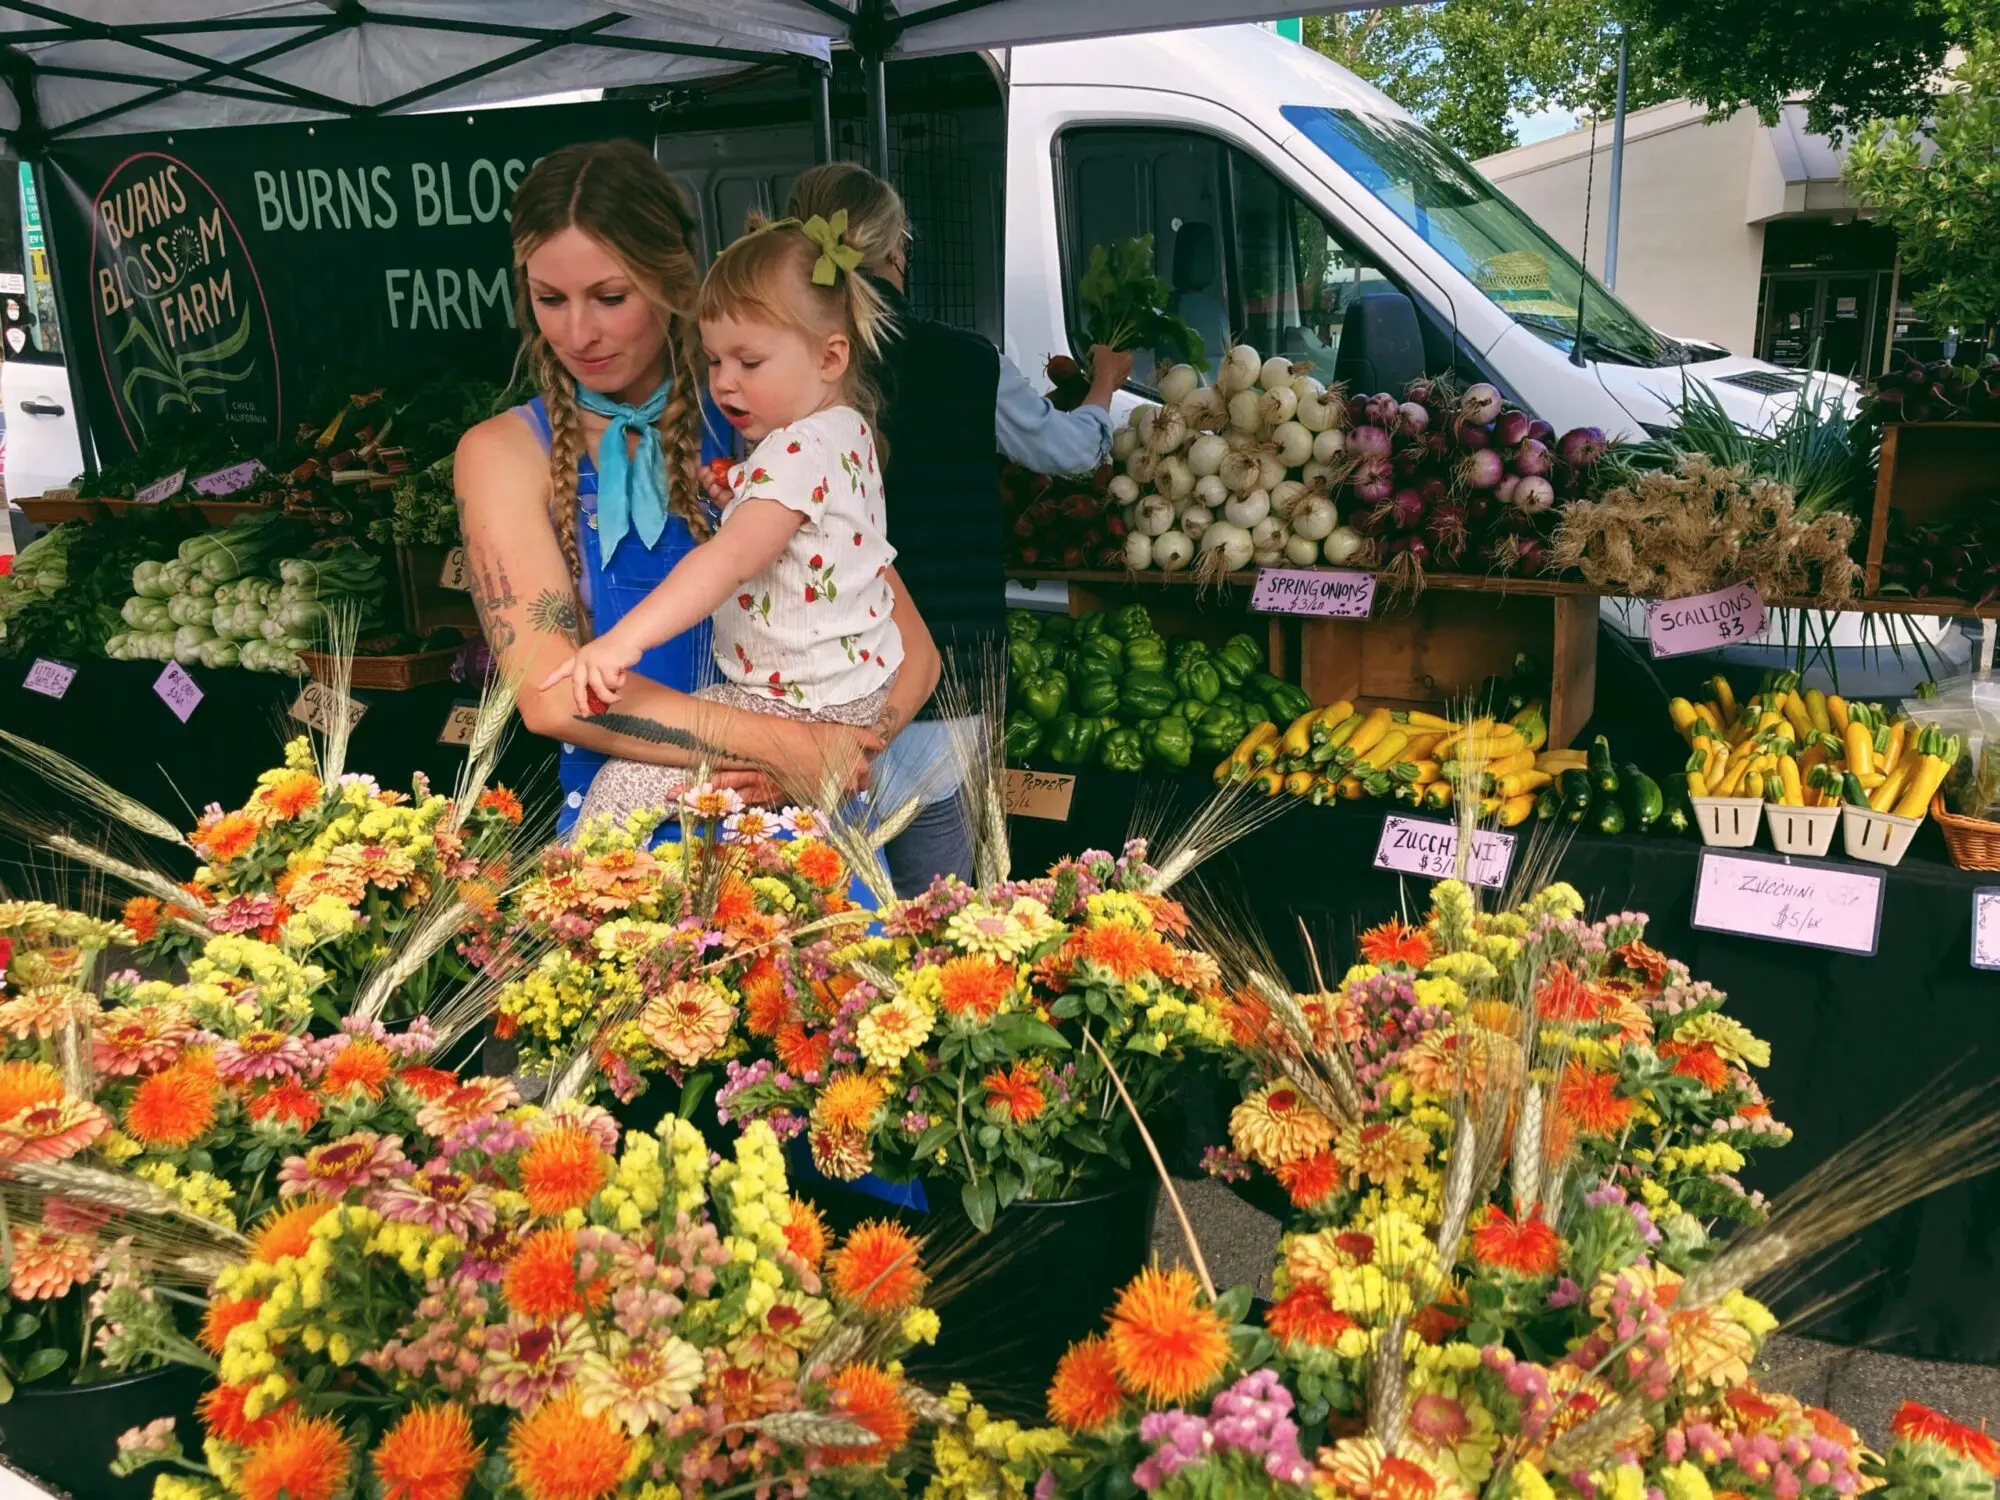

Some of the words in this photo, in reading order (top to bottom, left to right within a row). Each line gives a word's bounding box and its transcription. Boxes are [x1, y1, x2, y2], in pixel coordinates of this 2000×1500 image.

[100, 165, 187, 249] BURNS
[254, 165, 398, 231] BURNS
[411, 157, 545, 227] BLOS
[160, 269, 235, 348] FARM
[385, 267, 517, 330] FARM
[225, 413, 269, 424] CALIFORNIA
[1267, 577, 1319, 597] SPRING
[1321, 582, 1369, 603] ONIONS
[1660, 593, 1752, 631] SCALLIONS
[1718, 617, 1745, 639] $3
[1021, 772, 1073, 793] PEPPER
[1393, 829, 1497, 861] ZUCCHNI
[1738, 875, 1814, 899] ZUCCHINI
